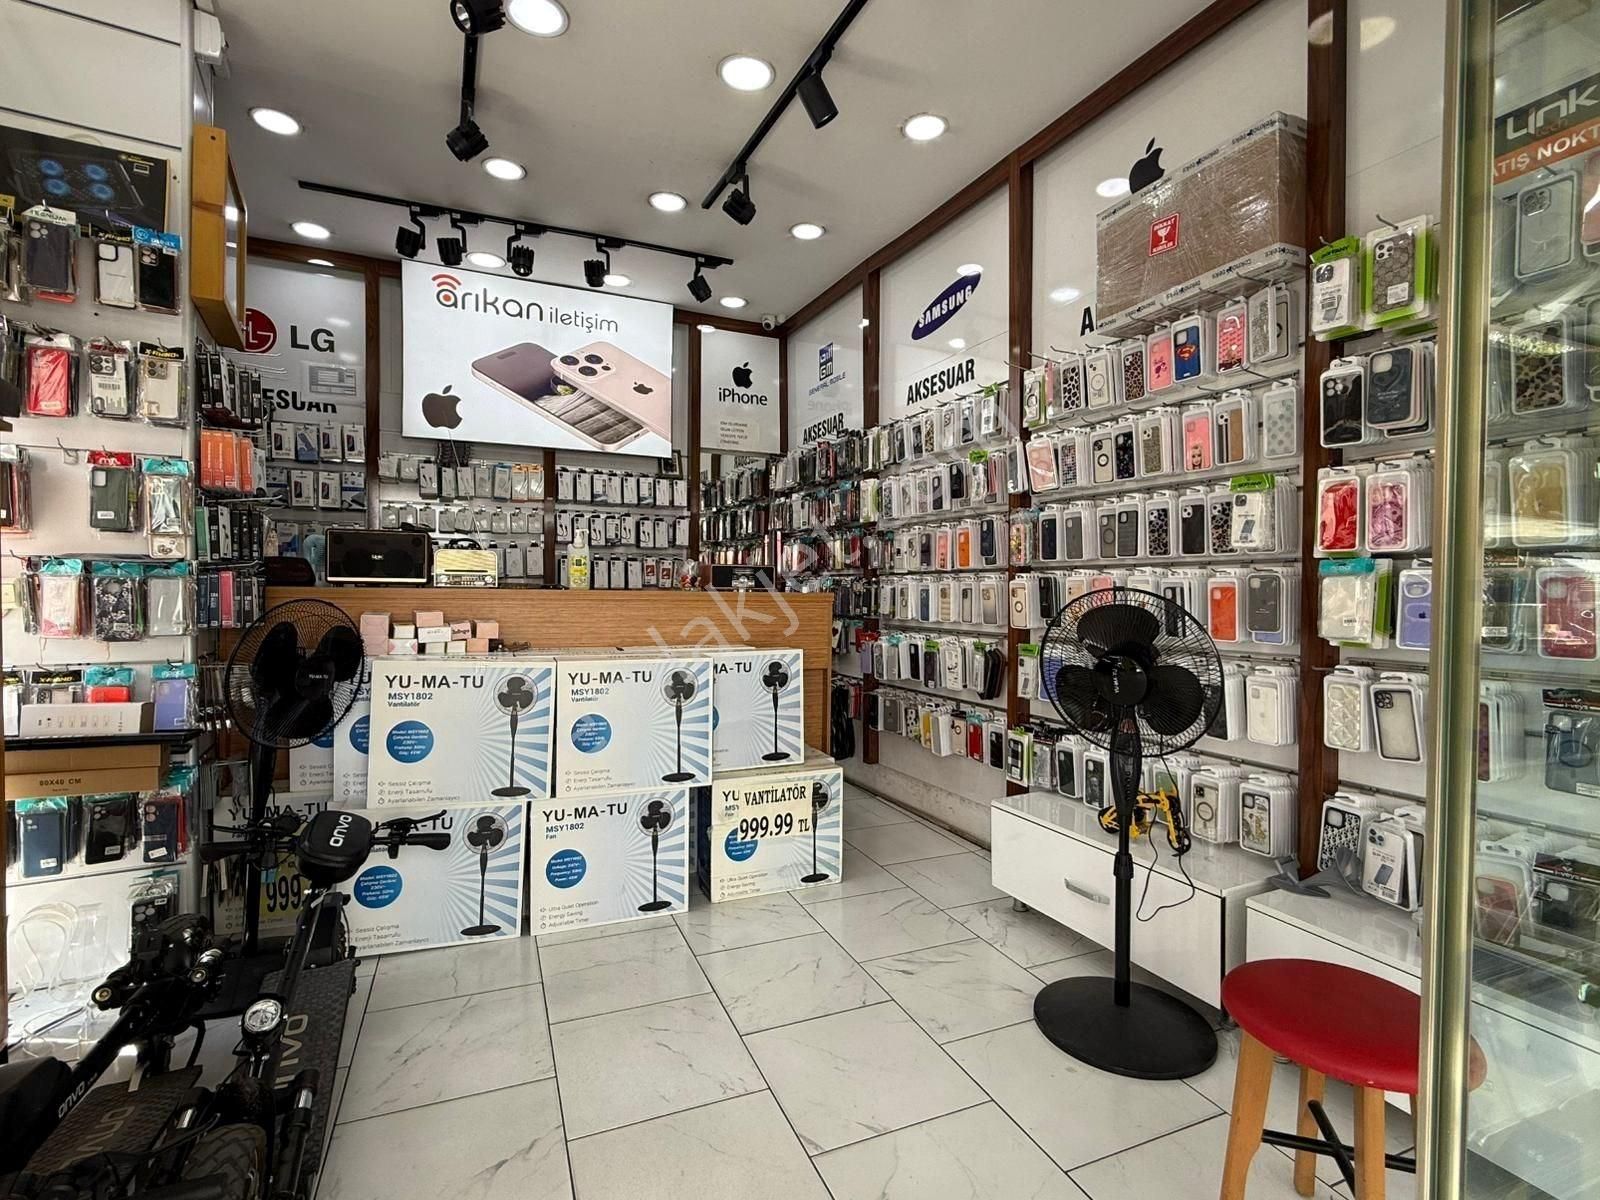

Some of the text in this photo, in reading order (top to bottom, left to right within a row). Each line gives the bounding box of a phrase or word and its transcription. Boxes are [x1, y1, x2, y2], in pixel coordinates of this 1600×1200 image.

[435, 286, 619, 334] arıkan iletişim
[918, 283, 972, 328] SAMSUNG
[290, 325, 335, 353] LG
[906, 358, 976, 406] AKSESUAR
[718, 387, 768, 406] iPhone
[803, 412, 845, 445] AKSESUAR
[385, 674, 484, 689] YU-MA-TU
[569, 671, 652, 685] YU-MA-TU
[388, 692, 433, 701] MSY1802
[571, 688, 609, 696] MSY1802
[744, 783, 807, 806] VANTİLATÖR
[543, 802, 628, 822] YU-MA-TU
[329, 814, 352, 848] onvo
[546, 823, 585, 833] MSY1802
[740, 812, 810, 841] 999.99 TL
